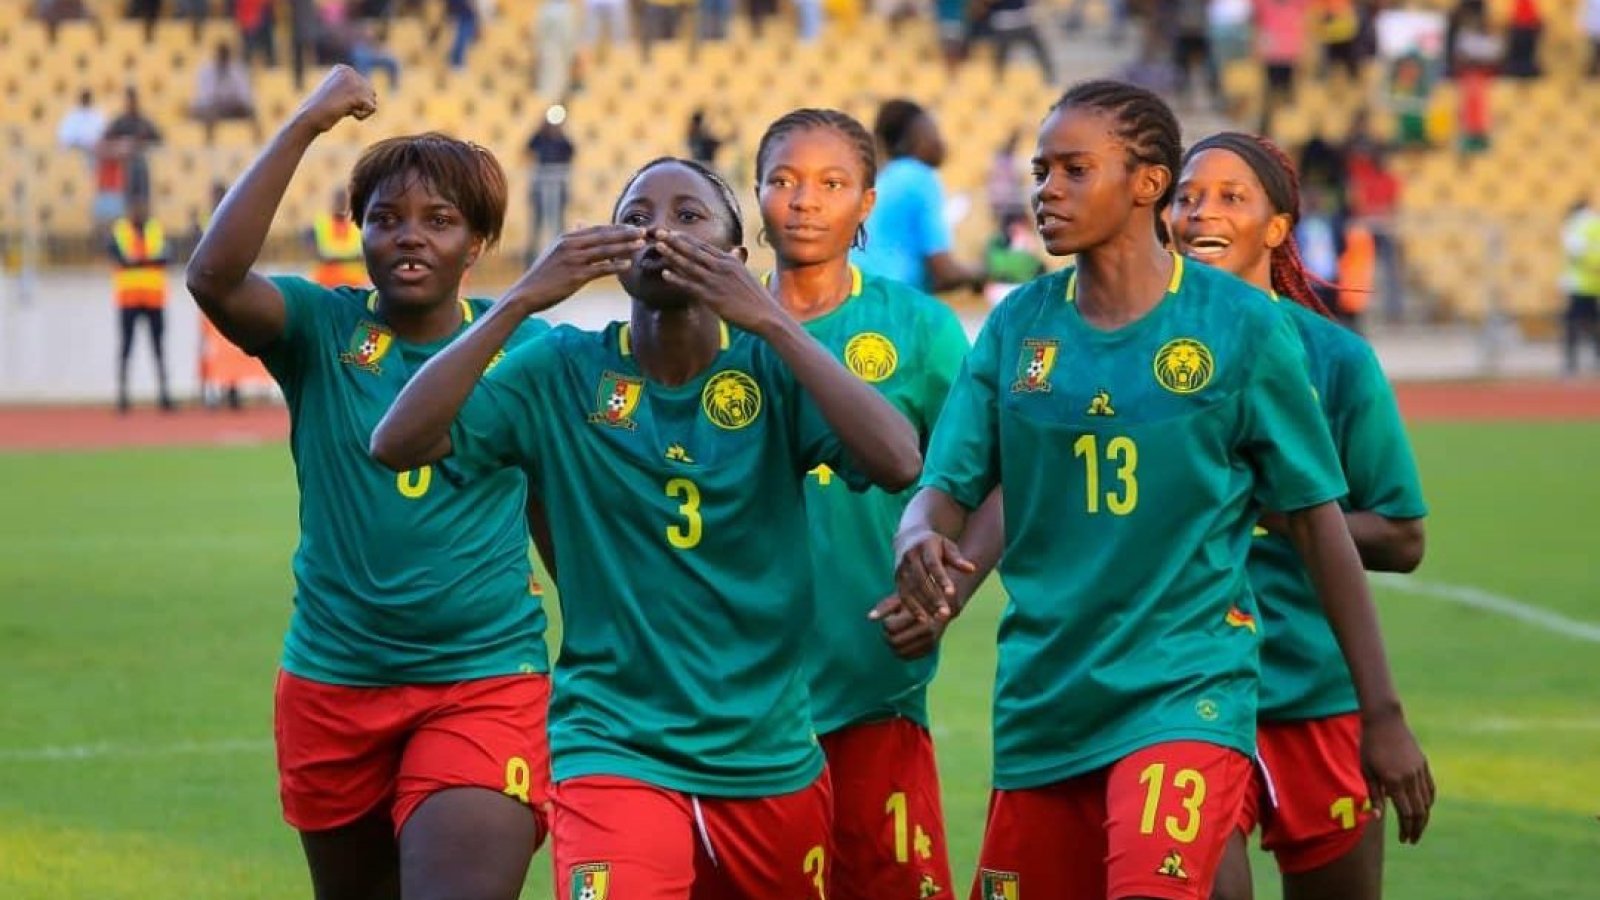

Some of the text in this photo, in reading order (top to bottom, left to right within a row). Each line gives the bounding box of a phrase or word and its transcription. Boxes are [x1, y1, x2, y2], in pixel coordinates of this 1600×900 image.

[665, 478, 703, 550] 3
[1073, 435, 1138, 515] 13
[1139, 763, 1207, 843] 13
